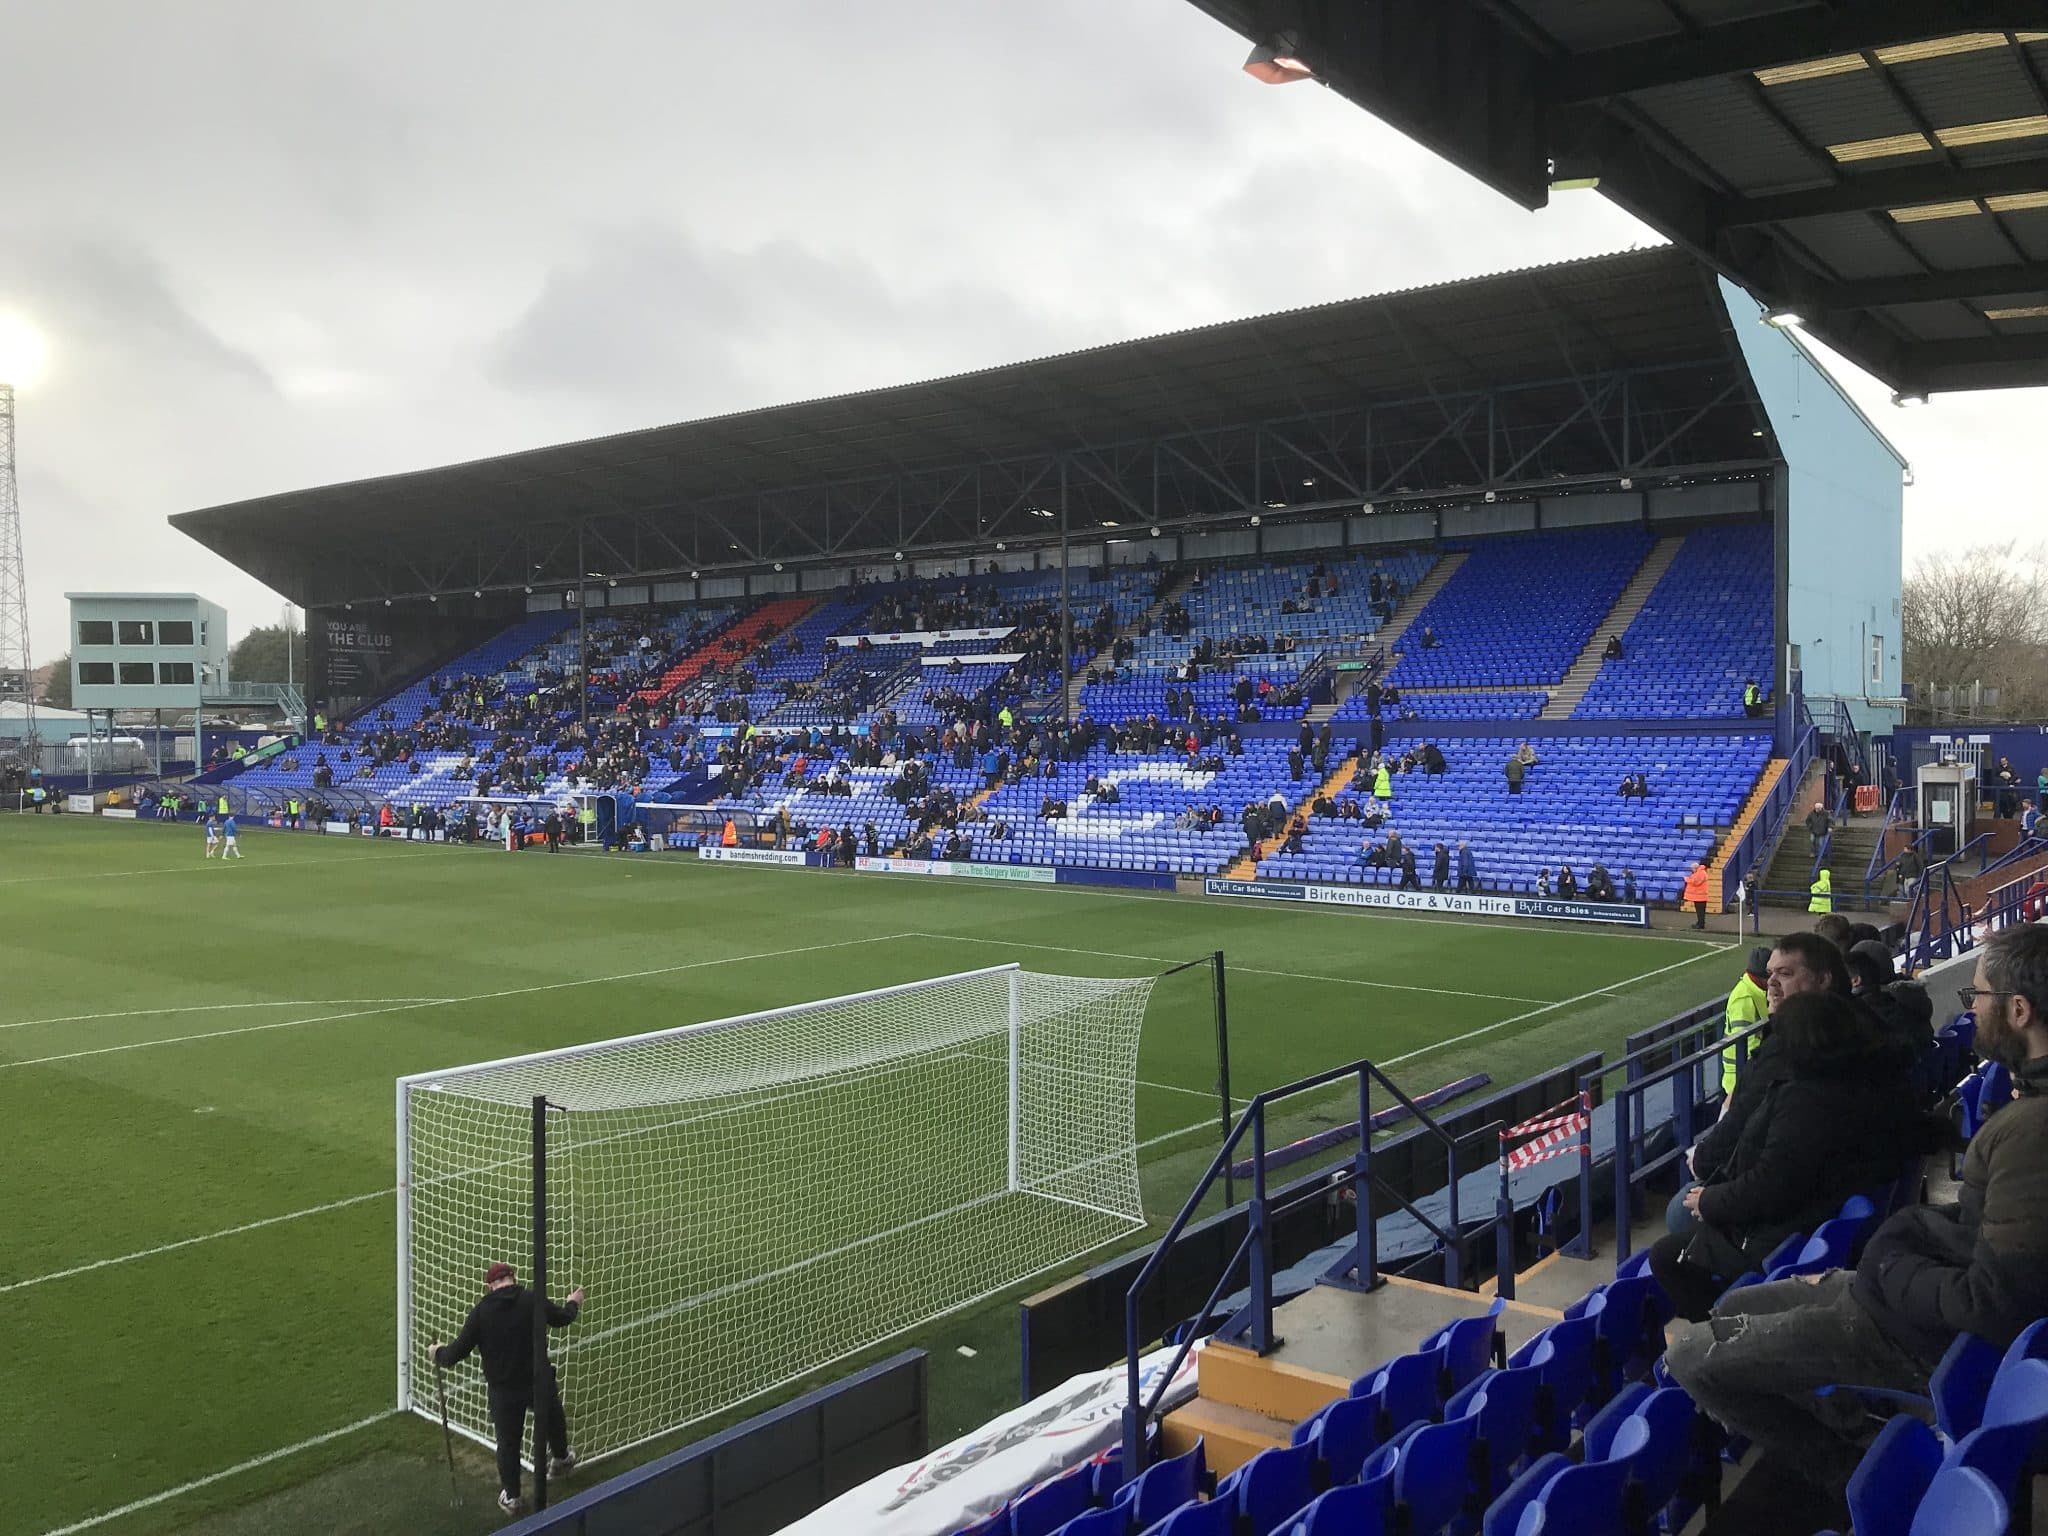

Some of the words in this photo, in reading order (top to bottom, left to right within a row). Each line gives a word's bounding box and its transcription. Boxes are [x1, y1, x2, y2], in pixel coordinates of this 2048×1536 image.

[328, 622, 347, 631] YOU
[328, 632, 354, 646] THE
[357, 634, 392, 647] CLUB
[729, 850, 798, 864] bandmshredding.com
[970, 865, 983, 875] Tree
[984, 866, 1009, 878] Surgery
[1010, 868, 1030, 879] Wirral
[1232, 884, 1245, 892] Car
[1246, 885, 1266, 894] Sales
[1309, 887, 1390, 904] Birkenhead
[1396, 893, 1422, 907] Car
[1428, 895, 1438, 908] &
[1444, 896, 1472, 910] Van
[1479, 899, 1511, 912] Hire
[1546, 904, 1562, 913] Car
[1564, 905, 1589, 915] Sales
